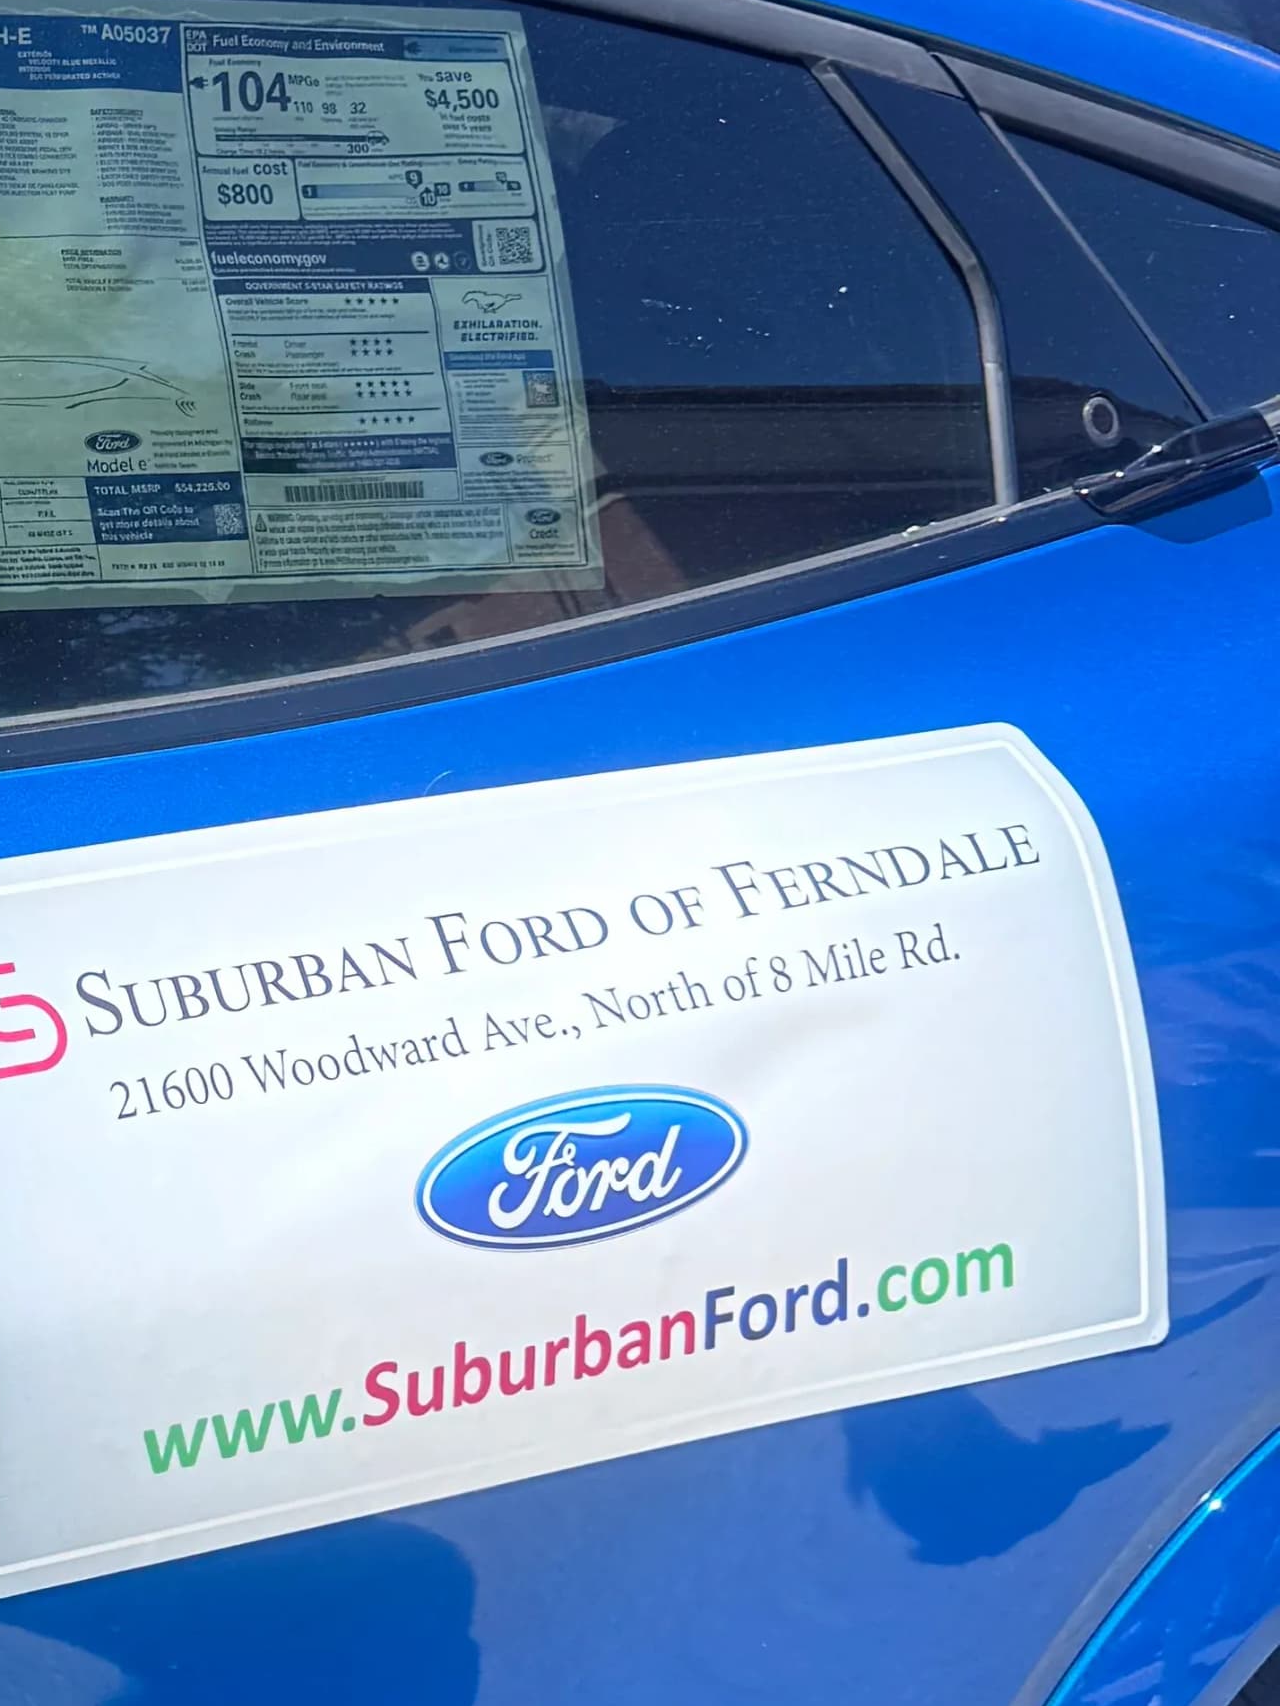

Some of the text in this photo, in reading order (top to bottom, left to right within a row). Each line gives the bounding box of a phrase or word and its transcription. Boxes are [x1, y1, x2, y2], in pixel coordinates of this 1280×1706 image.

[101, 23, 172, 45] A05037
[186, 29, 208, 40] EPA
[186, 43, 208, 53] DOT
[212, 34, 385, 53] Fuel Economy and Environment
[435, 70, 473, 83] save
[212, 70, 291, 113] 104
[288, 74, 320, 88] MPGe
[293, 100, 368, 115] 110 98 32
[424, 88, 500, 112] $4,500
[347, 143, 369, 154] 300
[252, 161, 288, 177] cost
[216, 183, 274, 209] $800
[421, 193, 436, 206] 10
[453, 319, 543, 331] EXHILARATION.
[460, 331, 540, 343] ELECTRIFIED.
[86, 457, 148, 473] Model e
[93, 484, 129, 496] TOTAL
[131, 483, 161, 494] MSRP
[75, 824, 1041, 1037] SUBURBAN FORD OF FERNDALE
[109, 922, 961, 1120] 21600 Woodward Ave., North of 8 Mile Rd.
[487, 1111, 683, 1230] Ford
[143, 1234, 1016, 1477] www.SuburbanFord.com
